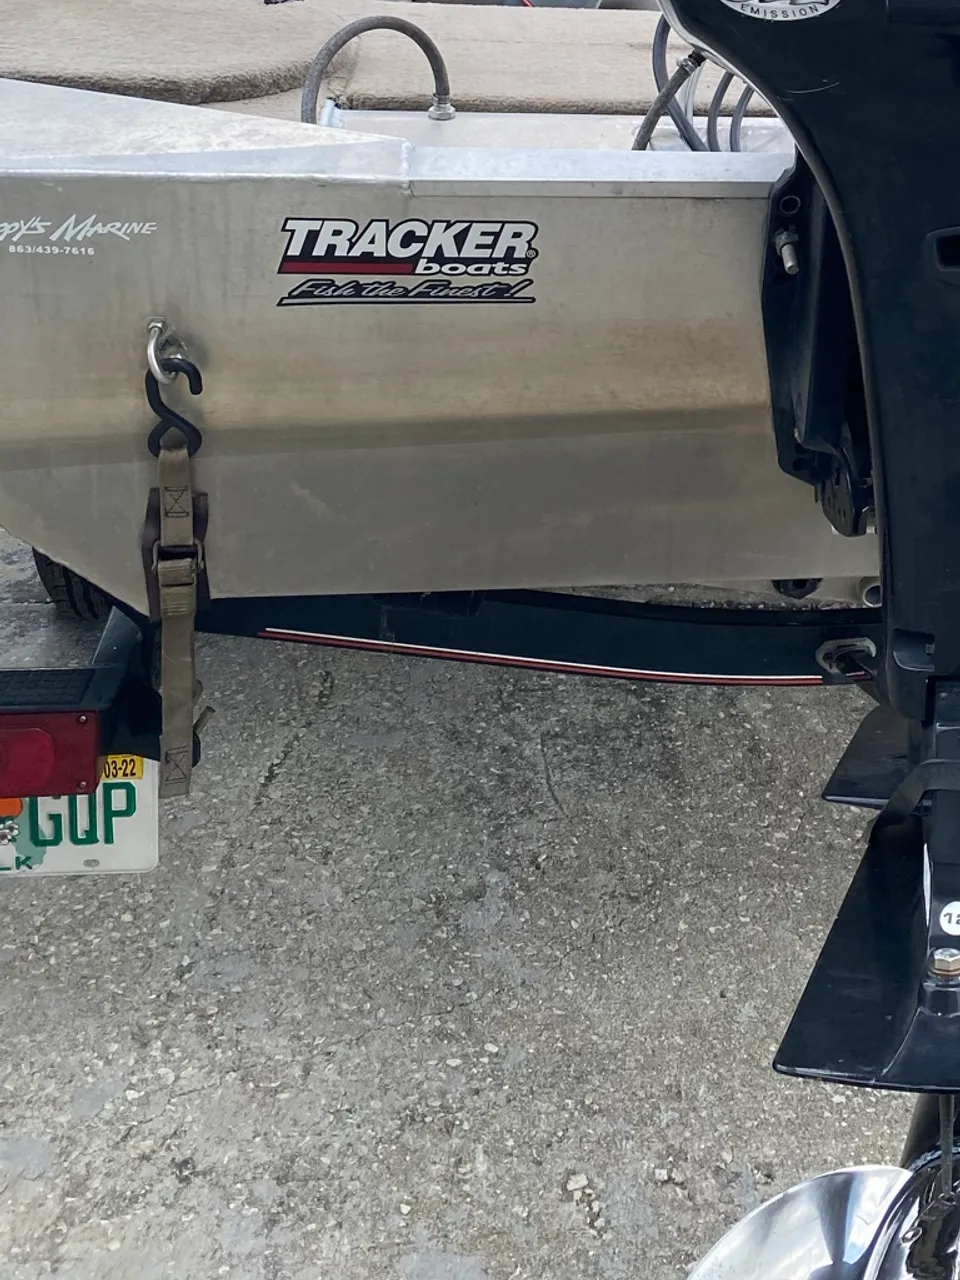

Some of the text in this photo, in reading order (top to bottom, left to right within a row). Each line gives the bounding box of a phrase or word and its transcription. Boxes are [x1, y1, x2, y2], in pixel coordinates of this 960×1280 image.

[740, 3, 820, 19] EMISSION
[284, 219, 534, 259] TRACKER
[415, 258, 528, 275] boats
[291, 280, 357, 297] Fish
[361, 281, 405, 297] the
[104, 758, 137, 779] 03-22
